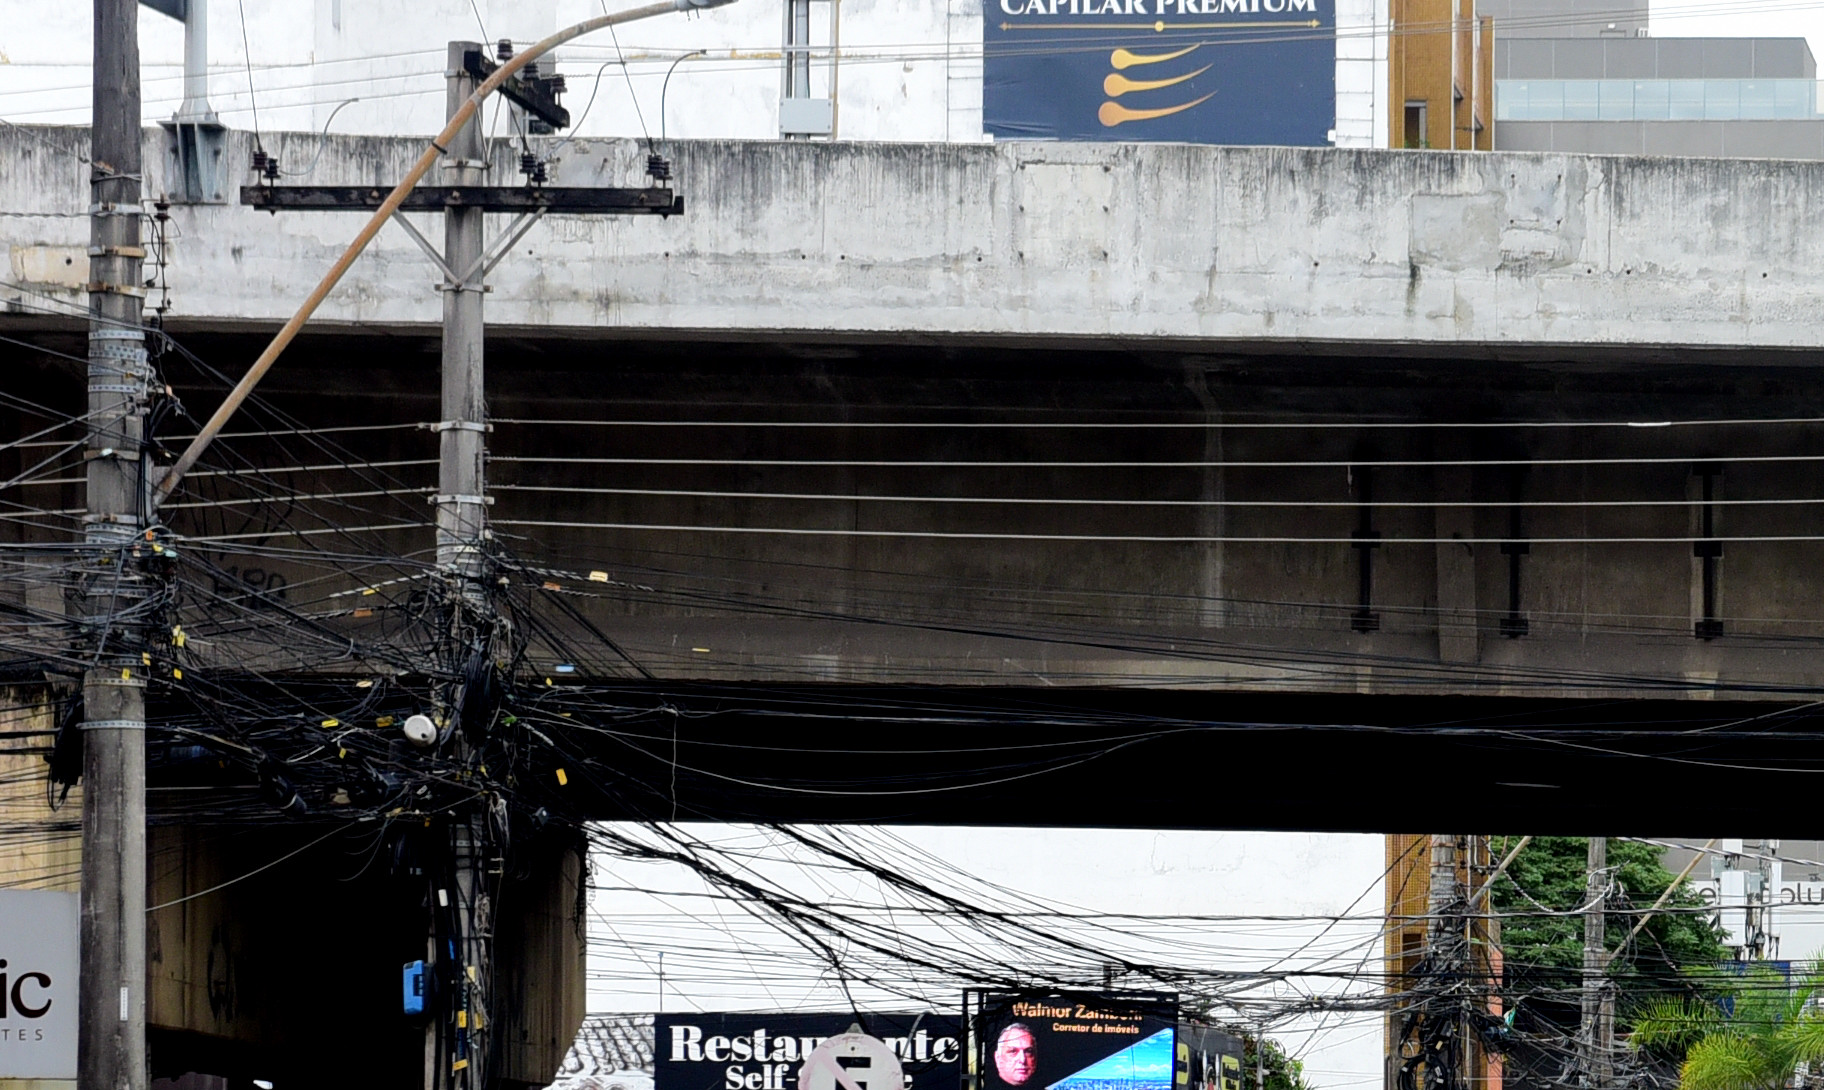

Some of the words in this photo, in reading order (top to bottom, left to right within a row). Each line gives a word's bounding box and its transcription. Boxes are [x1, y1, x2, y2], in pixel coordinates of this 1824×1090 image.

[1001, 0, 1148, 15] CAPILAR
[1155, 0, 1318, 14] PREMIUM
[1012, 1002, 1071, 1018] Walmor
[1053, 1022, 1090, 1033] Corretor
[1092, 1022, 1103, 1033] de
[1104, 1022, 1140, 1034] imóveis
[668, 1025, 960, 1062] Restaunte
